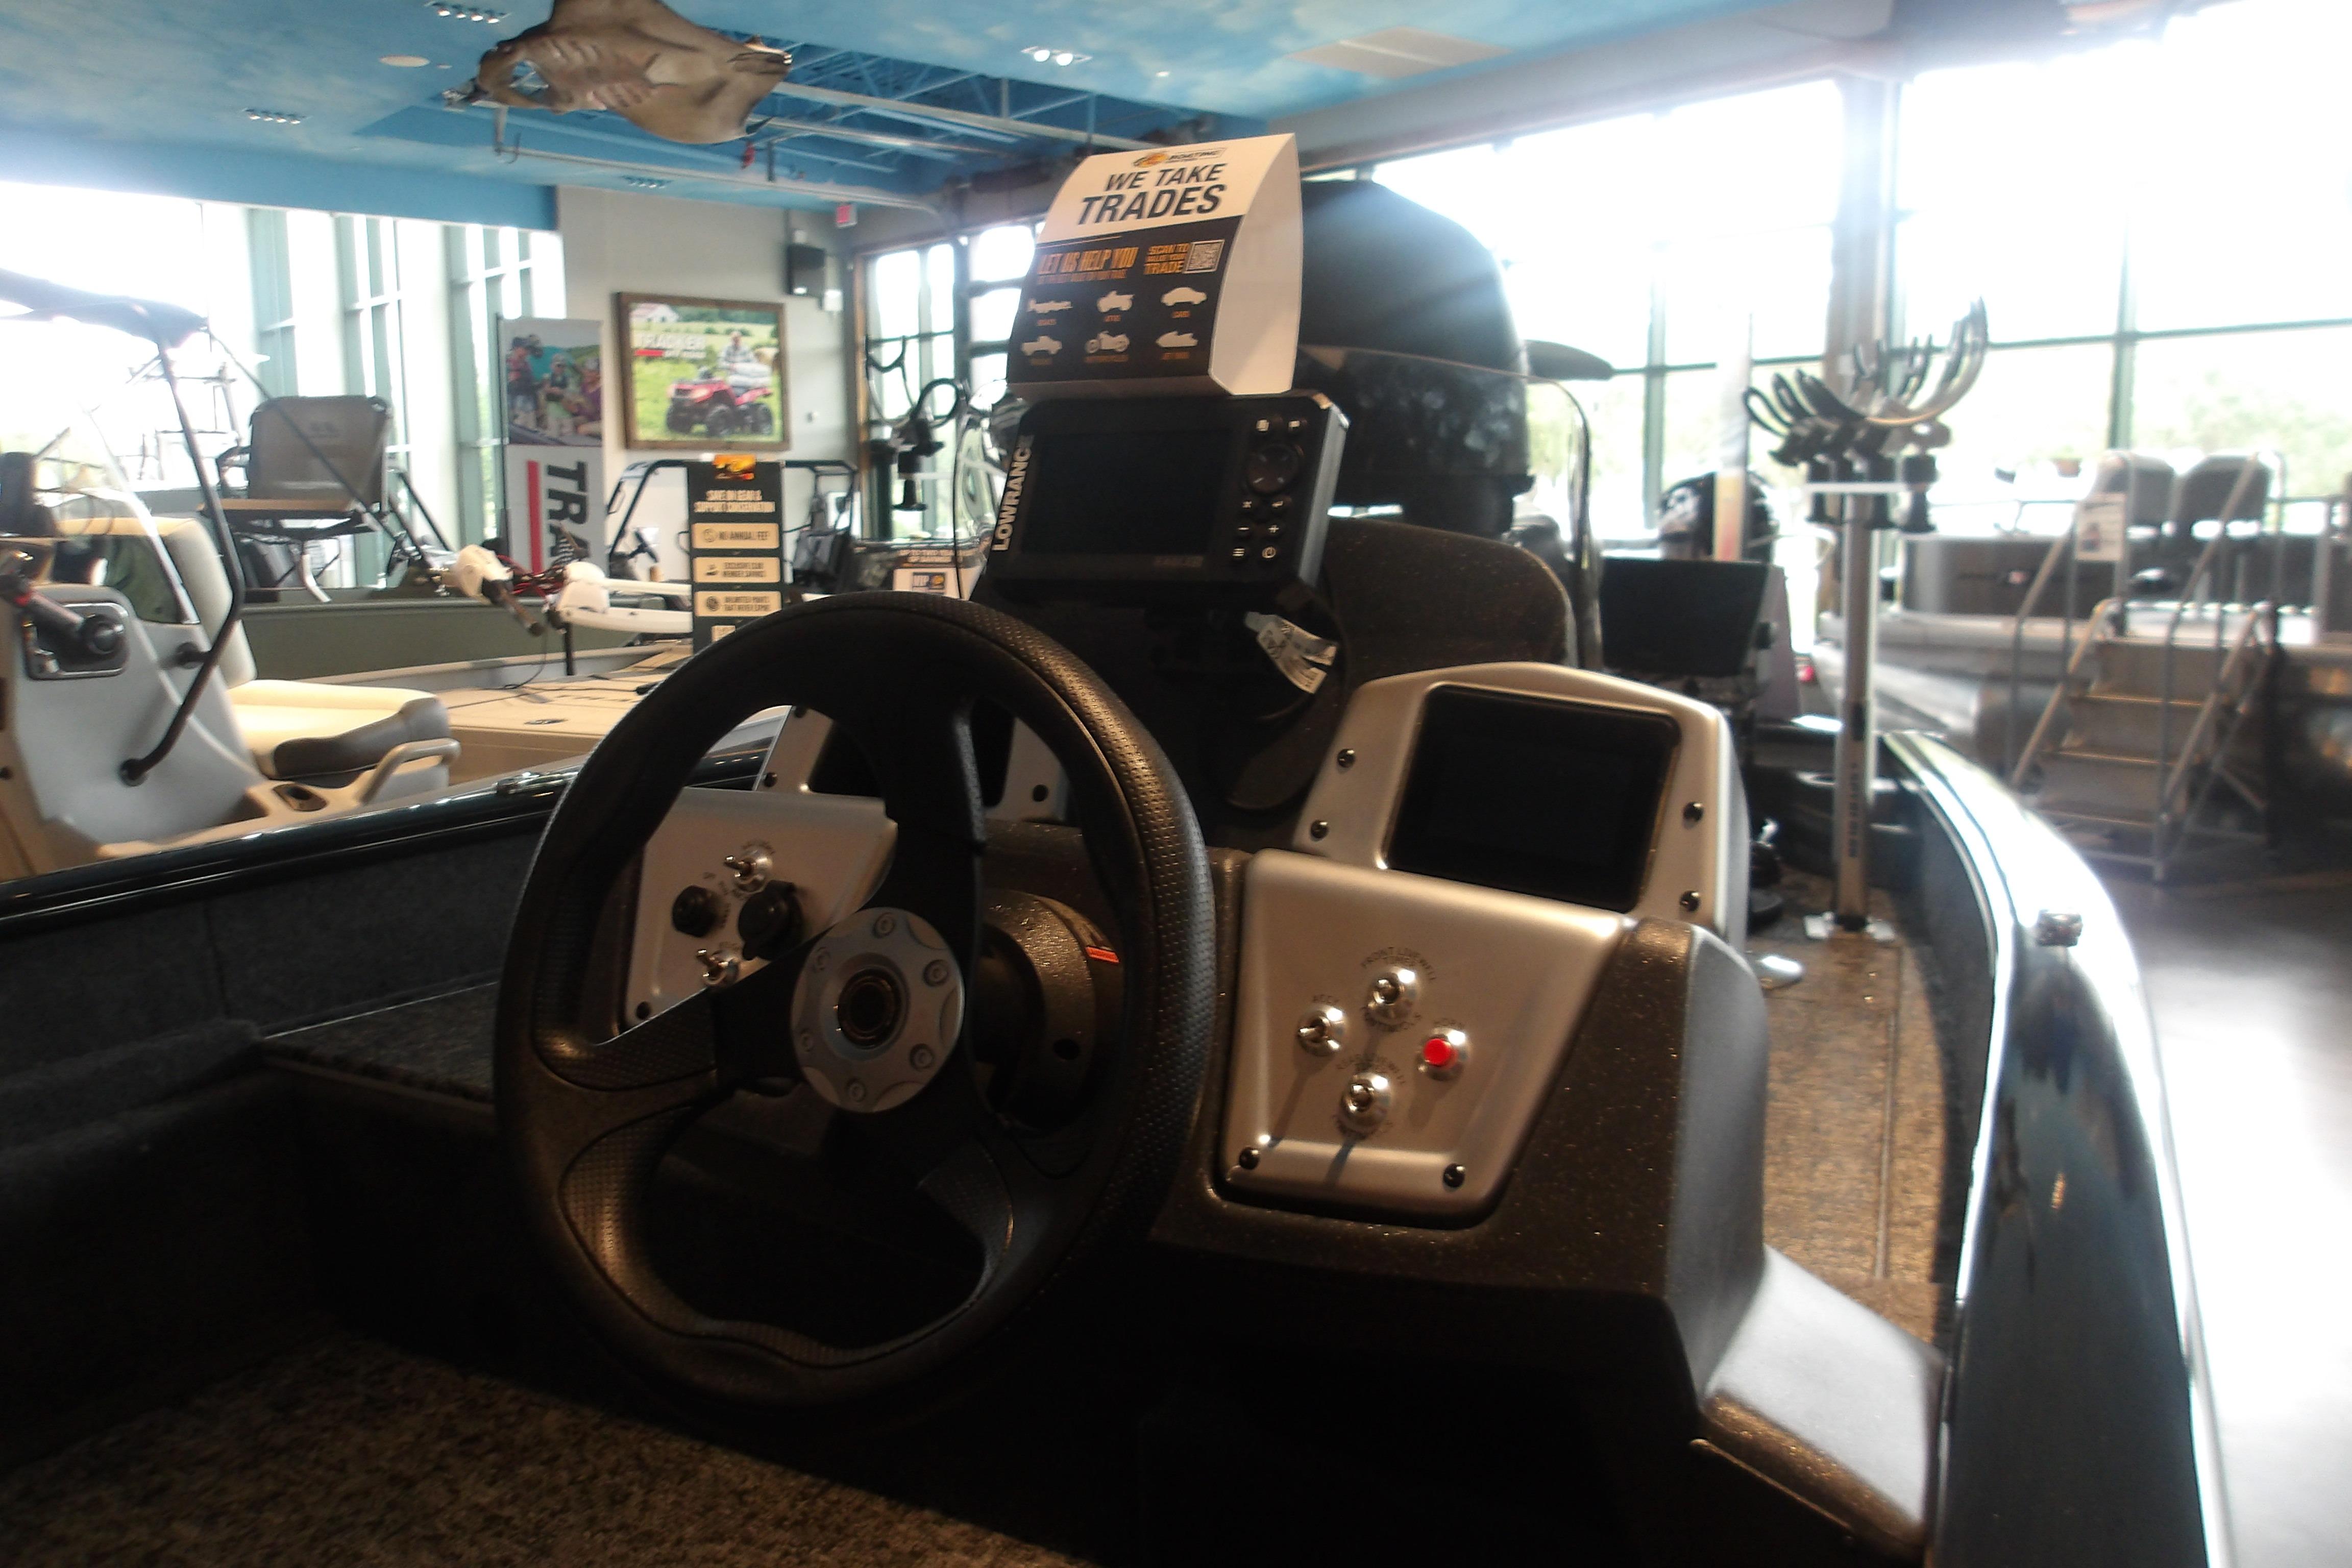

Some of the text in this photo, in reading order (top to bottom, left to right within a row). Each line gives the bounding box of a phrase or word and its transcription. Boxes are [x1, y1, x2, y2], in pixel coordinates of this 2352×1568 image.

[1105, 163, 1228, 191] WE TAKE
[1078, 184, 1228, 225] TRADES
[1037, 247, 1139, 275] LET US HELP YOU
[1143, 261, 1185, 275] TRADE
